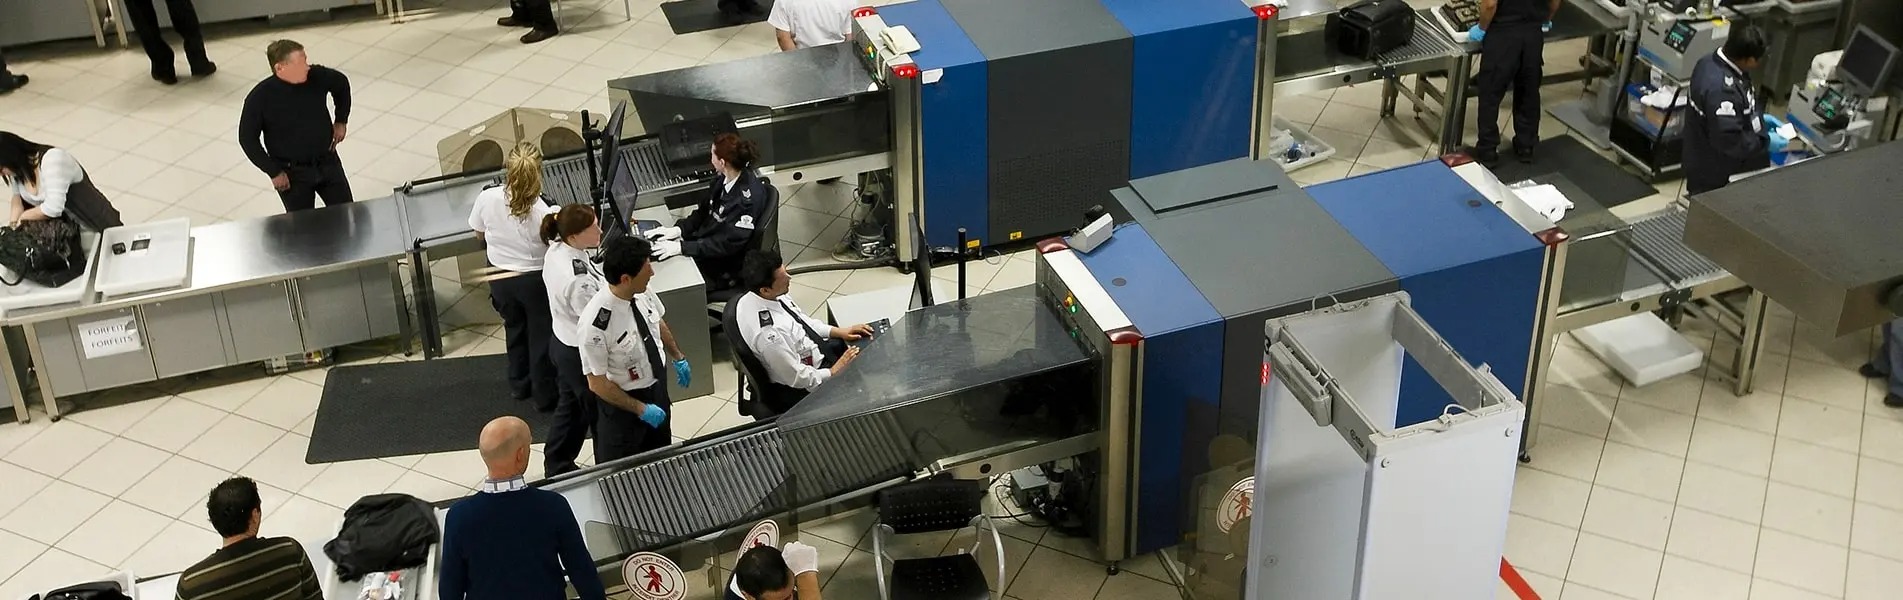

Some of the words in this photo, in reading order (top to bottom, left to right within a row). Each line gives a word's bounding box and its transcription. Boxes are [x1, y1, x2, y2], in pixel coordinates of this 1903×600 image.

[87, 324, 127, 337] FORFEIT
[91, 336, 133, 349] FORFEITS
[632, 558, 642, 566] DO
[655, 558, 675, 572] ENTER
